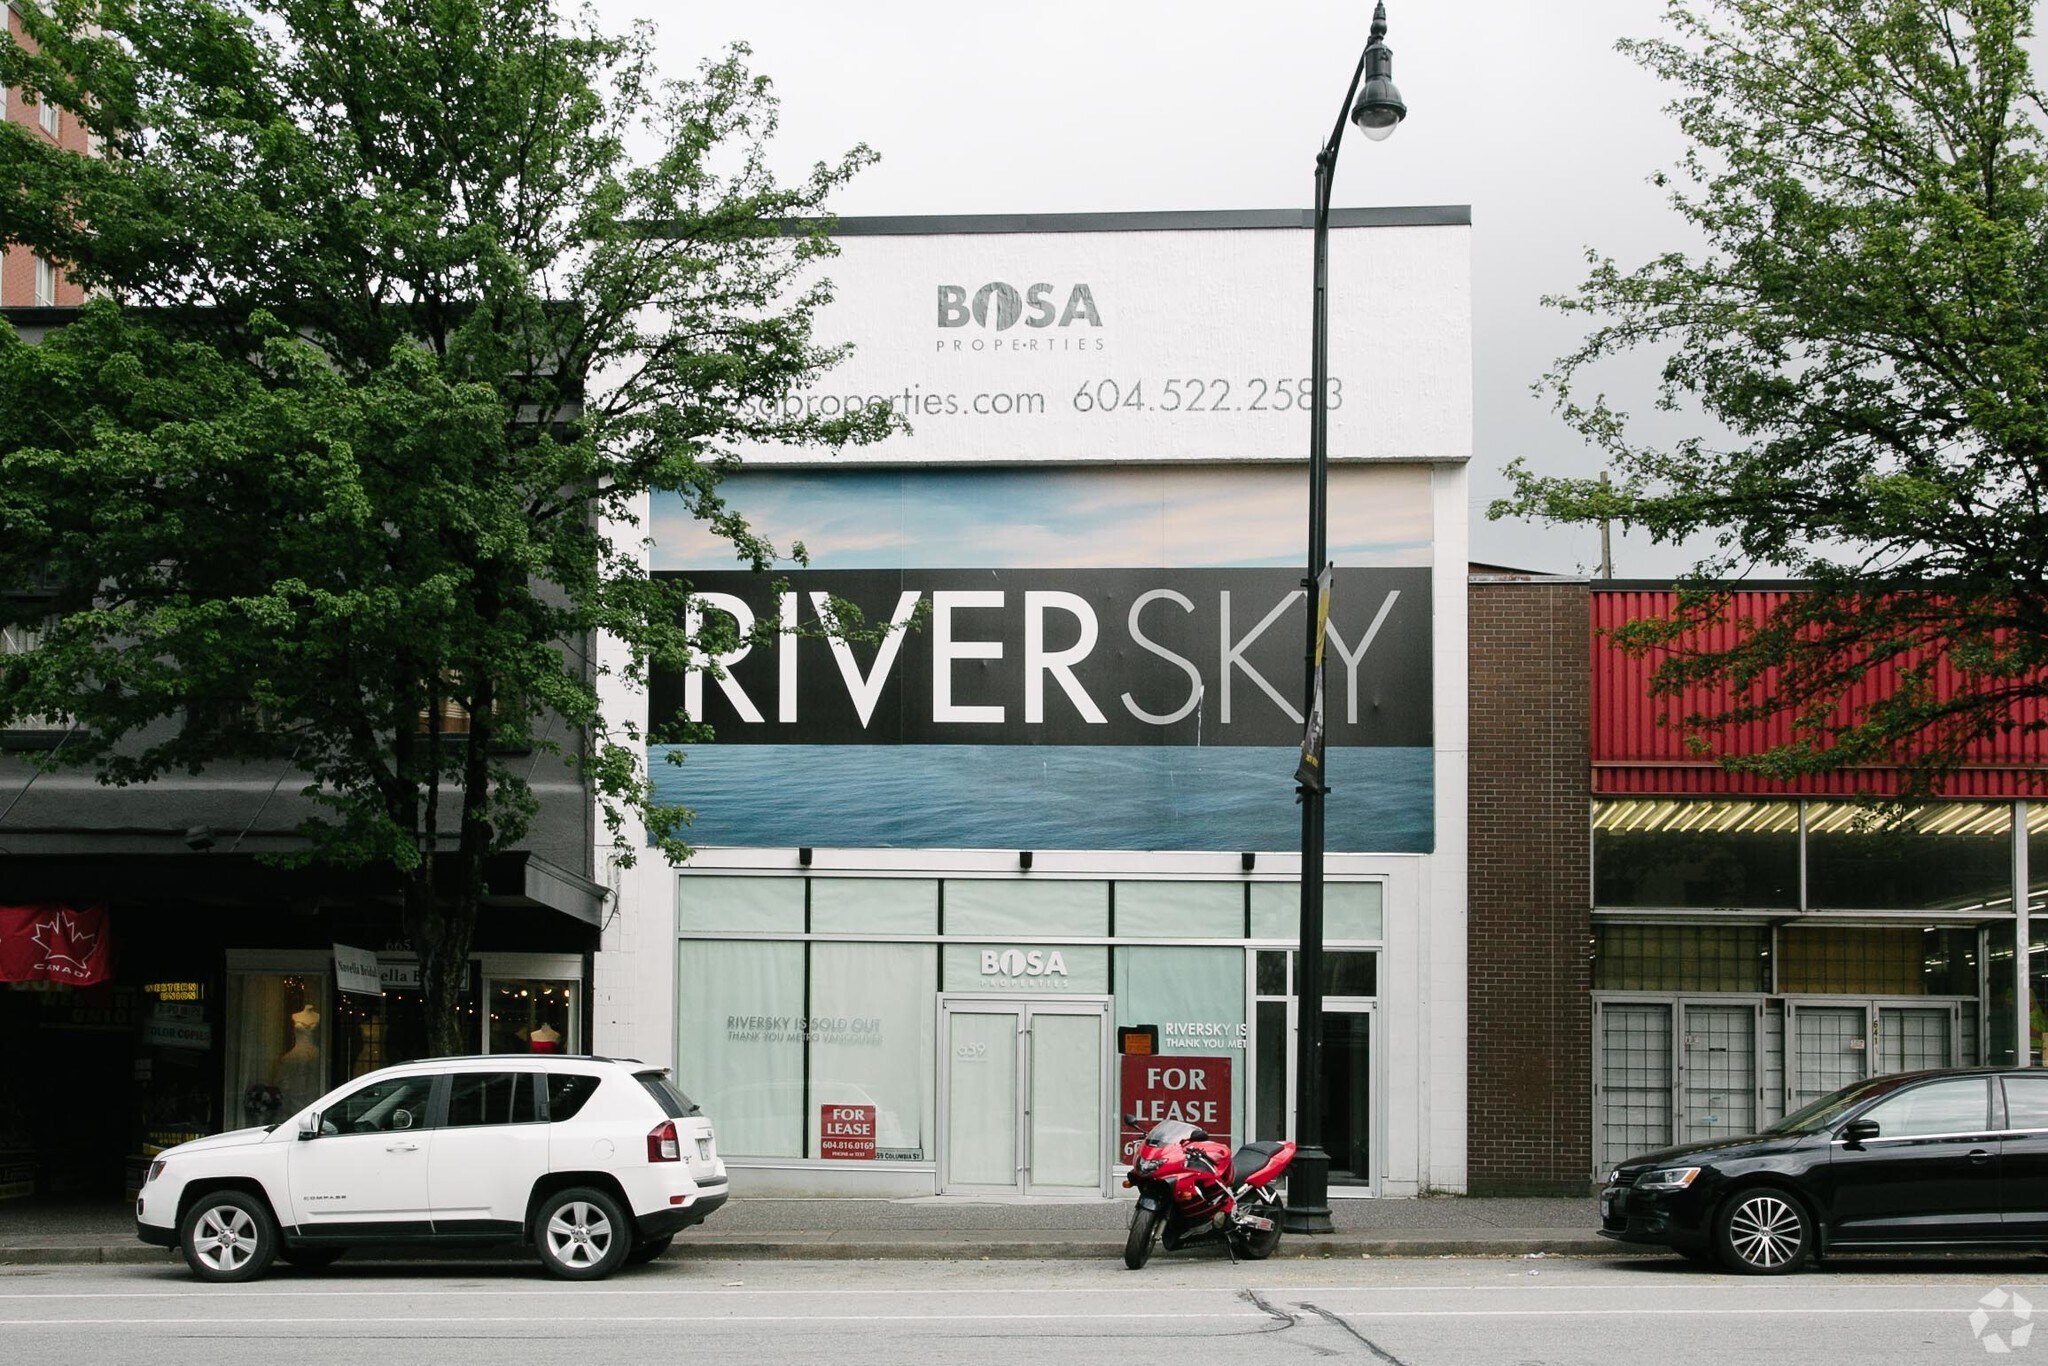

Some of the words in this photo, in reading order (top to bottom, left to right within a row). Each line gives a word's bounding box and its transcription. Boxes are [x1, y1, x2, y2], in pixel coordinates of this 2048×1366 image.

[937, 281, 1103, 331] BOSA
[936, 338, 1104, 352] PROPERTIES
[1073, 378, 1342, 411] 604.522.2583
[685, 589, 1401, 729] RIVERSKY
[385, 939, 412, 951] 665
[980, 949, 1068, 977] BOSA
[380, 968, 408, 982] ella
[980, 979, 1069, 988] PROPERTIES
[727, 1015, 790, 1030] RIVERSKY
[811, 1017, 848, 1032] SOLD
[851, 1017, 882, 1033] OUT
[1165, 1022, 1231, 1036] RIVERSKY
[1236, 1023, 1247, 1037] IS
[727, 1030, 761, 1041] THANK
[763, 1031, 784, 1042] YOU
[1166, 1038, 1200, 1048] THANK
[1202, 1038, 1225, 1049] YOU
[1147, 1067, 1207, 1090] FOR
[833, 1108, 865, 1120] FOR
[1135, 1099, 1218, 1123] LEASE
[827, 1123, 870, 1135] LEASE
[822, 1141, 874, 1150] 604.816.0169
